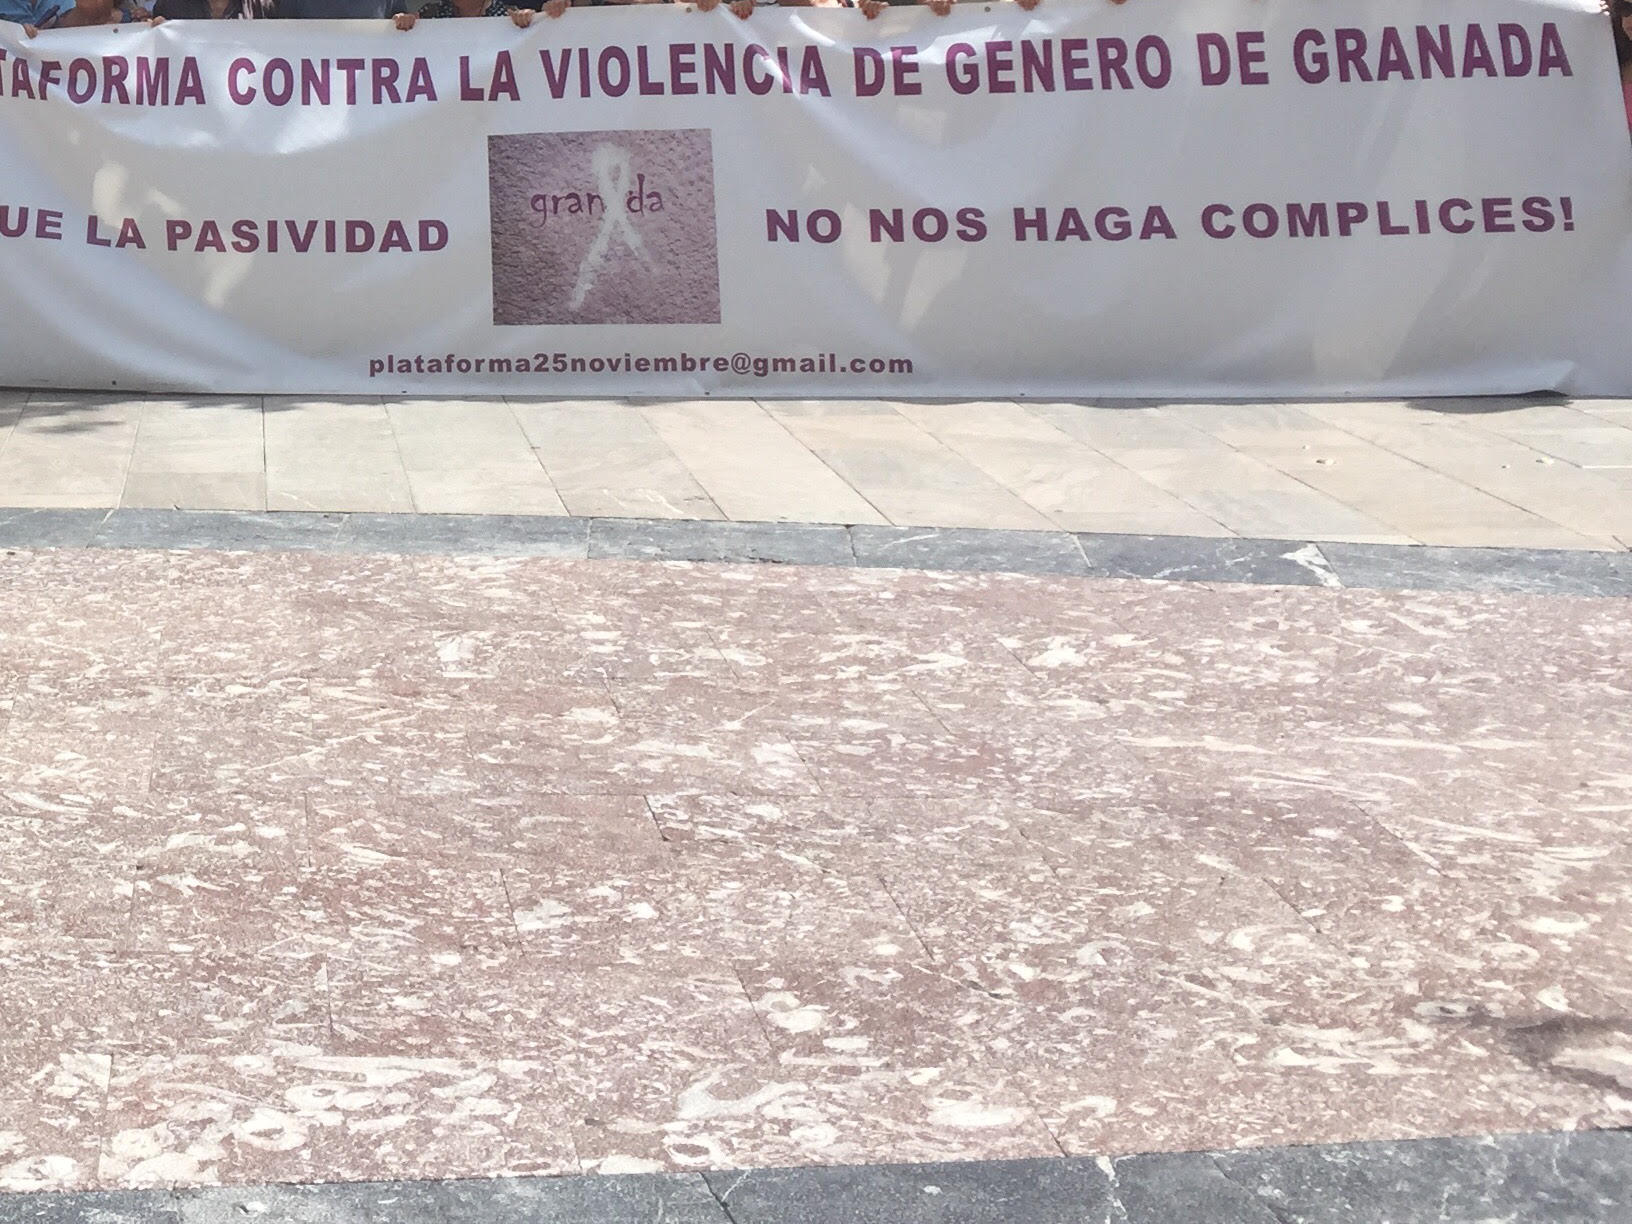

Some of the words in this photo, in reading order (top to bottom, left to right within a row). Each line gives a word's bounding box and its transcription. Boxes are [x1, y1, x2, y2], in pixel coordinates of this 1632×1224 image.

[227, 56, 438, 107] CONTRA
[458, 50, 521, 102] LA
[538, 42, 832, 100] VIOLENCIA
[852, 44, 923, 97] DE
[945, 34, 1172, 96] GENERO
[1196, 31, 1270, 87] DE
[1292, 22, 1574, 85] GRANADA
[85, 213, 147, 250] LA
[165, 219, 450, 253] PASIVIDAD
[765, 208, 842, 244] NO
[869, 207, 988, 243] NOS
[1013, 205, 1179, 242] HAGA
[1200, 196, 1576, 240] COMPLICES!
[369, 352, 914, 378] plataforma25noviembre@gmail.com
